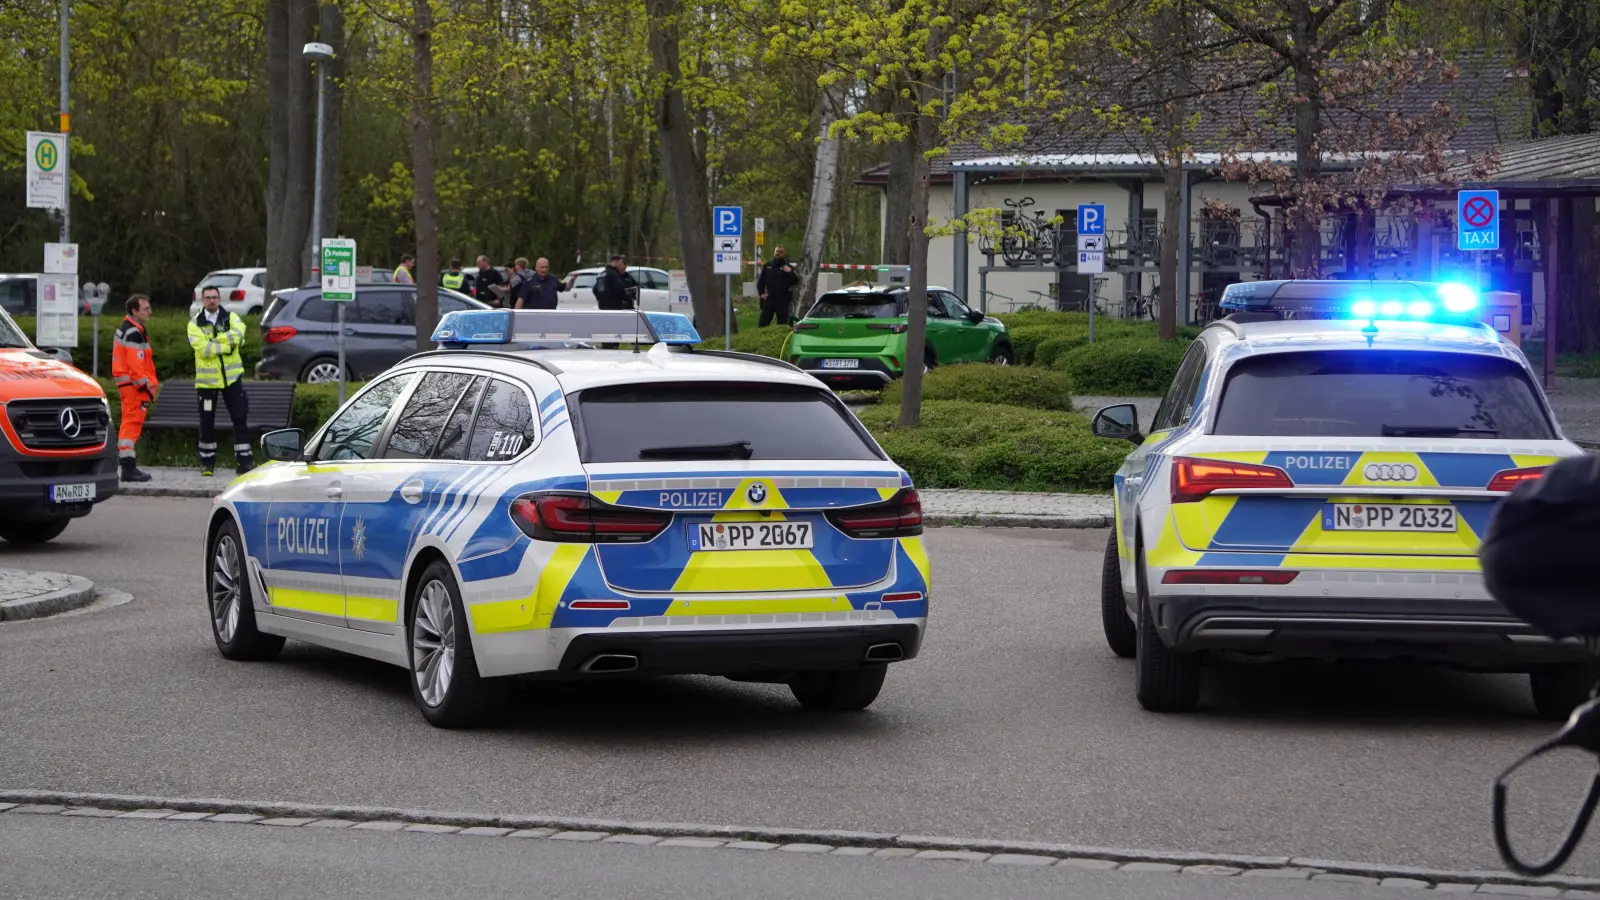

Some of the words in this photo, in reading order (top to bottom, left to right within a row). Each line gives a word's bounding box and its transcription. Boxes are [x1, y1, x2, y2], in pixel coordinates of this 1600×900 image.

[41, 146, 51, 164] H
[720, 211, 735, 232] P
[1083, 208, 1098, 231] P
[1463, 232, 1494, 244] TAXI
[499, 435, 523, 455] 110
[1285, 456, 1350, 469] POLIZEI
[56, 486, 68, 498] AN
[72, 485, 83, 497] RD
[84, 484, 90, 497] 3
[659, 492, 722, 507] POLIZEI
[1337, 506, 1350, 526] N
[1366, 507, 1394, 527] PP
[1399, 507, 1454, 528] 2032
[278, 517, 329, 554] POLIZEI
[700, 526, 715, 548] N
[727, 525, 755, 547] PP
[759, 524, 809, 546] 2067
